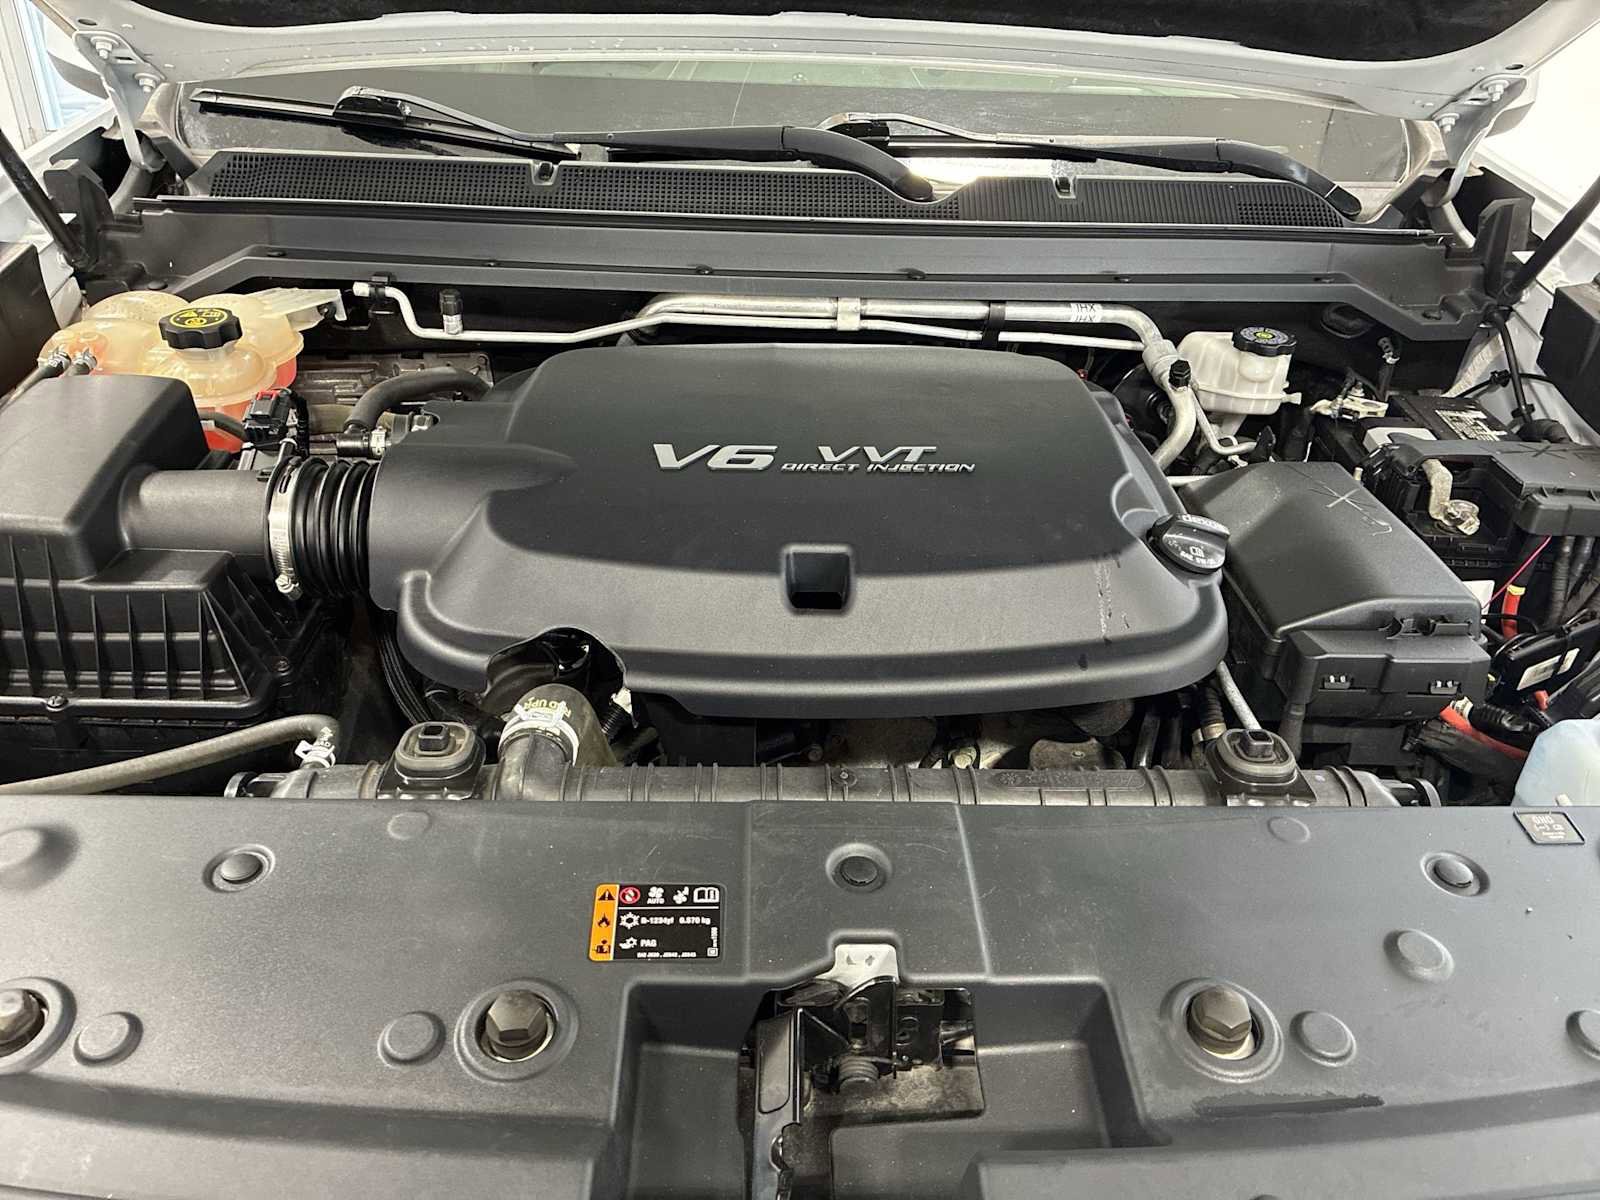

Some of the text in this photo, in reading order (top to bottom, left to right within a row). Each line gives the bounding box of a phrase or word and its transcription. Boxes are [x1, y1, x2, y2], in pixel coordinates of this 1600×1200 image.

[653, 443, 778, 471] V6
[817, 445, 937, 463] VVT
[781, 462, 976, 474] DIRECT INJECTION
[679, 916, 700, 925] 0.570
[701, 916, 711, 926] kg
[640, 939, 657, 948] PAG
